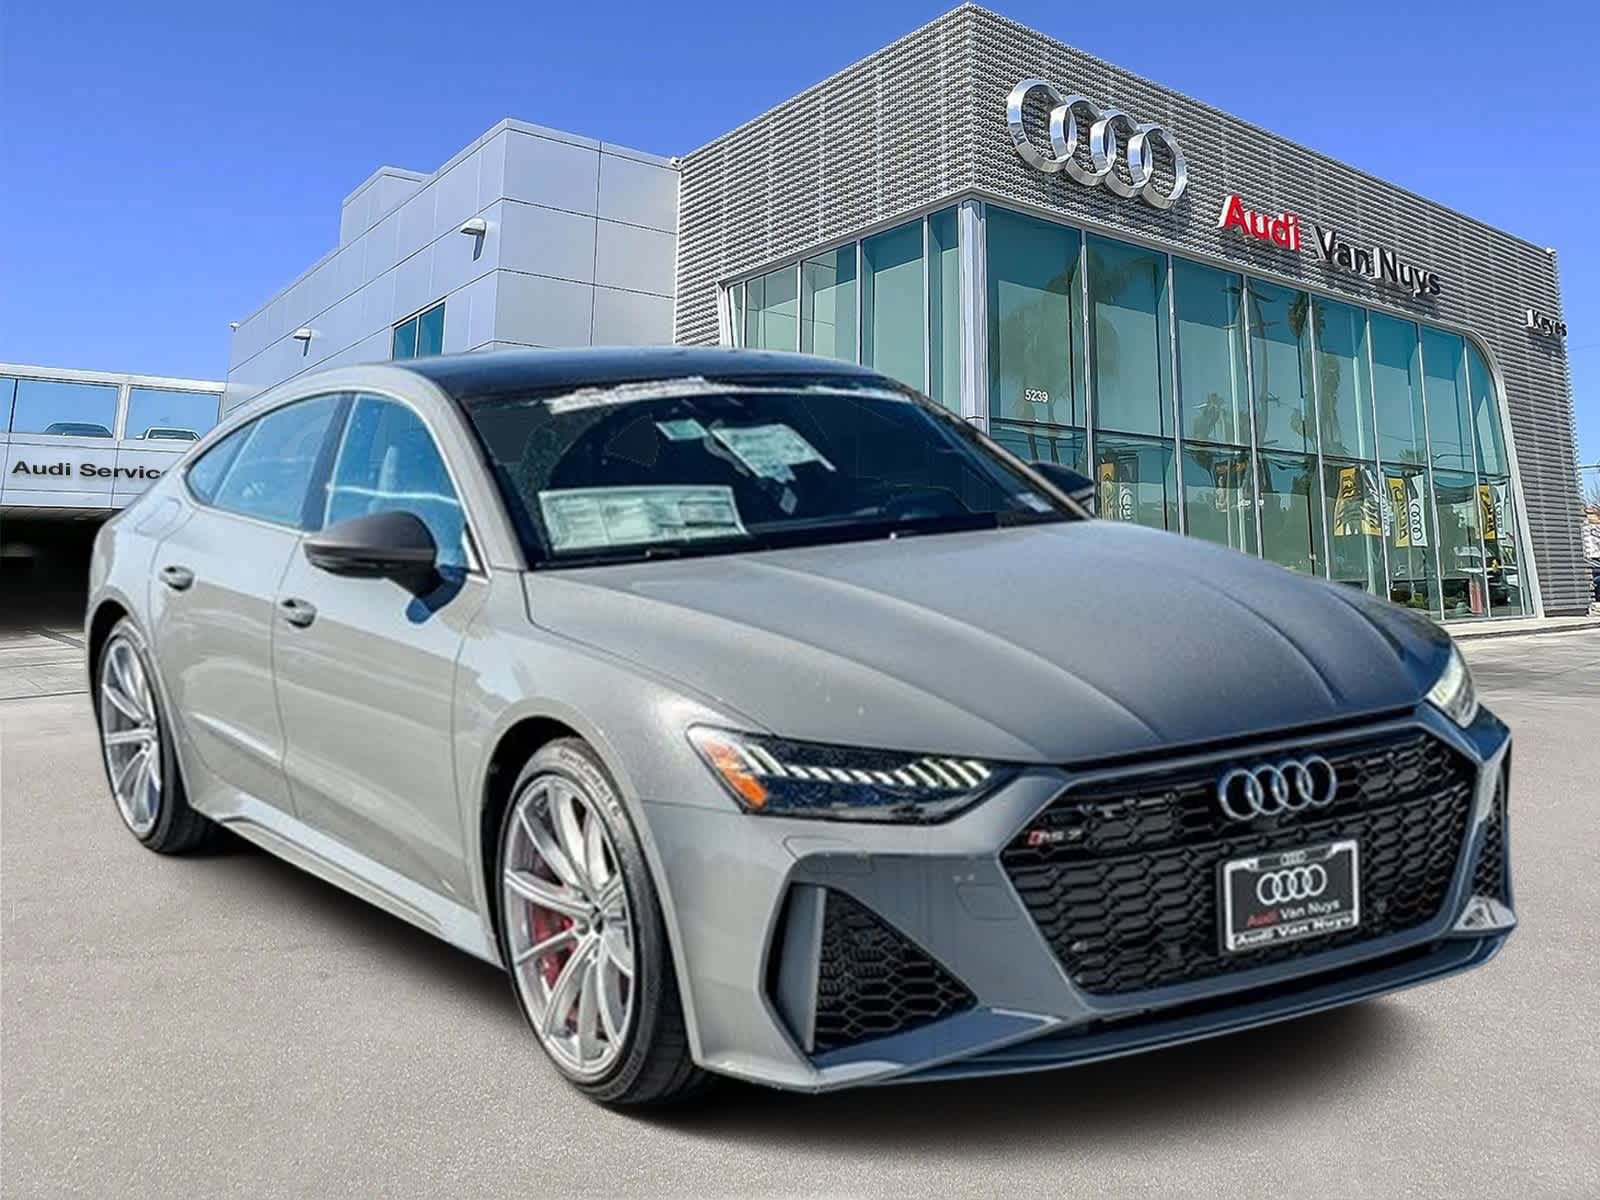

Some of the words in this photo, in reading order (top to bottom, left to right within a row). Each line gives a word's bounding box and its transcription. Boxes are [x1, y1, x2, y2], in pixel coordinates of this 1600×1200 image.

[1218, 194, 1301, 251] Audi
[1312, 225, 1369, 274] Van
[1373, 247, 1441, 297] Nuys
[1527, 309, 1568, 337] Keyes
[1024, 389, 1049, 403] 5239
[12, 461, 70, 476] Audi
[1280, 906, 1305, 920] Van
[1307, 900, 1340, 916] Nuys
[1277, 922, 1309, 937] Van
